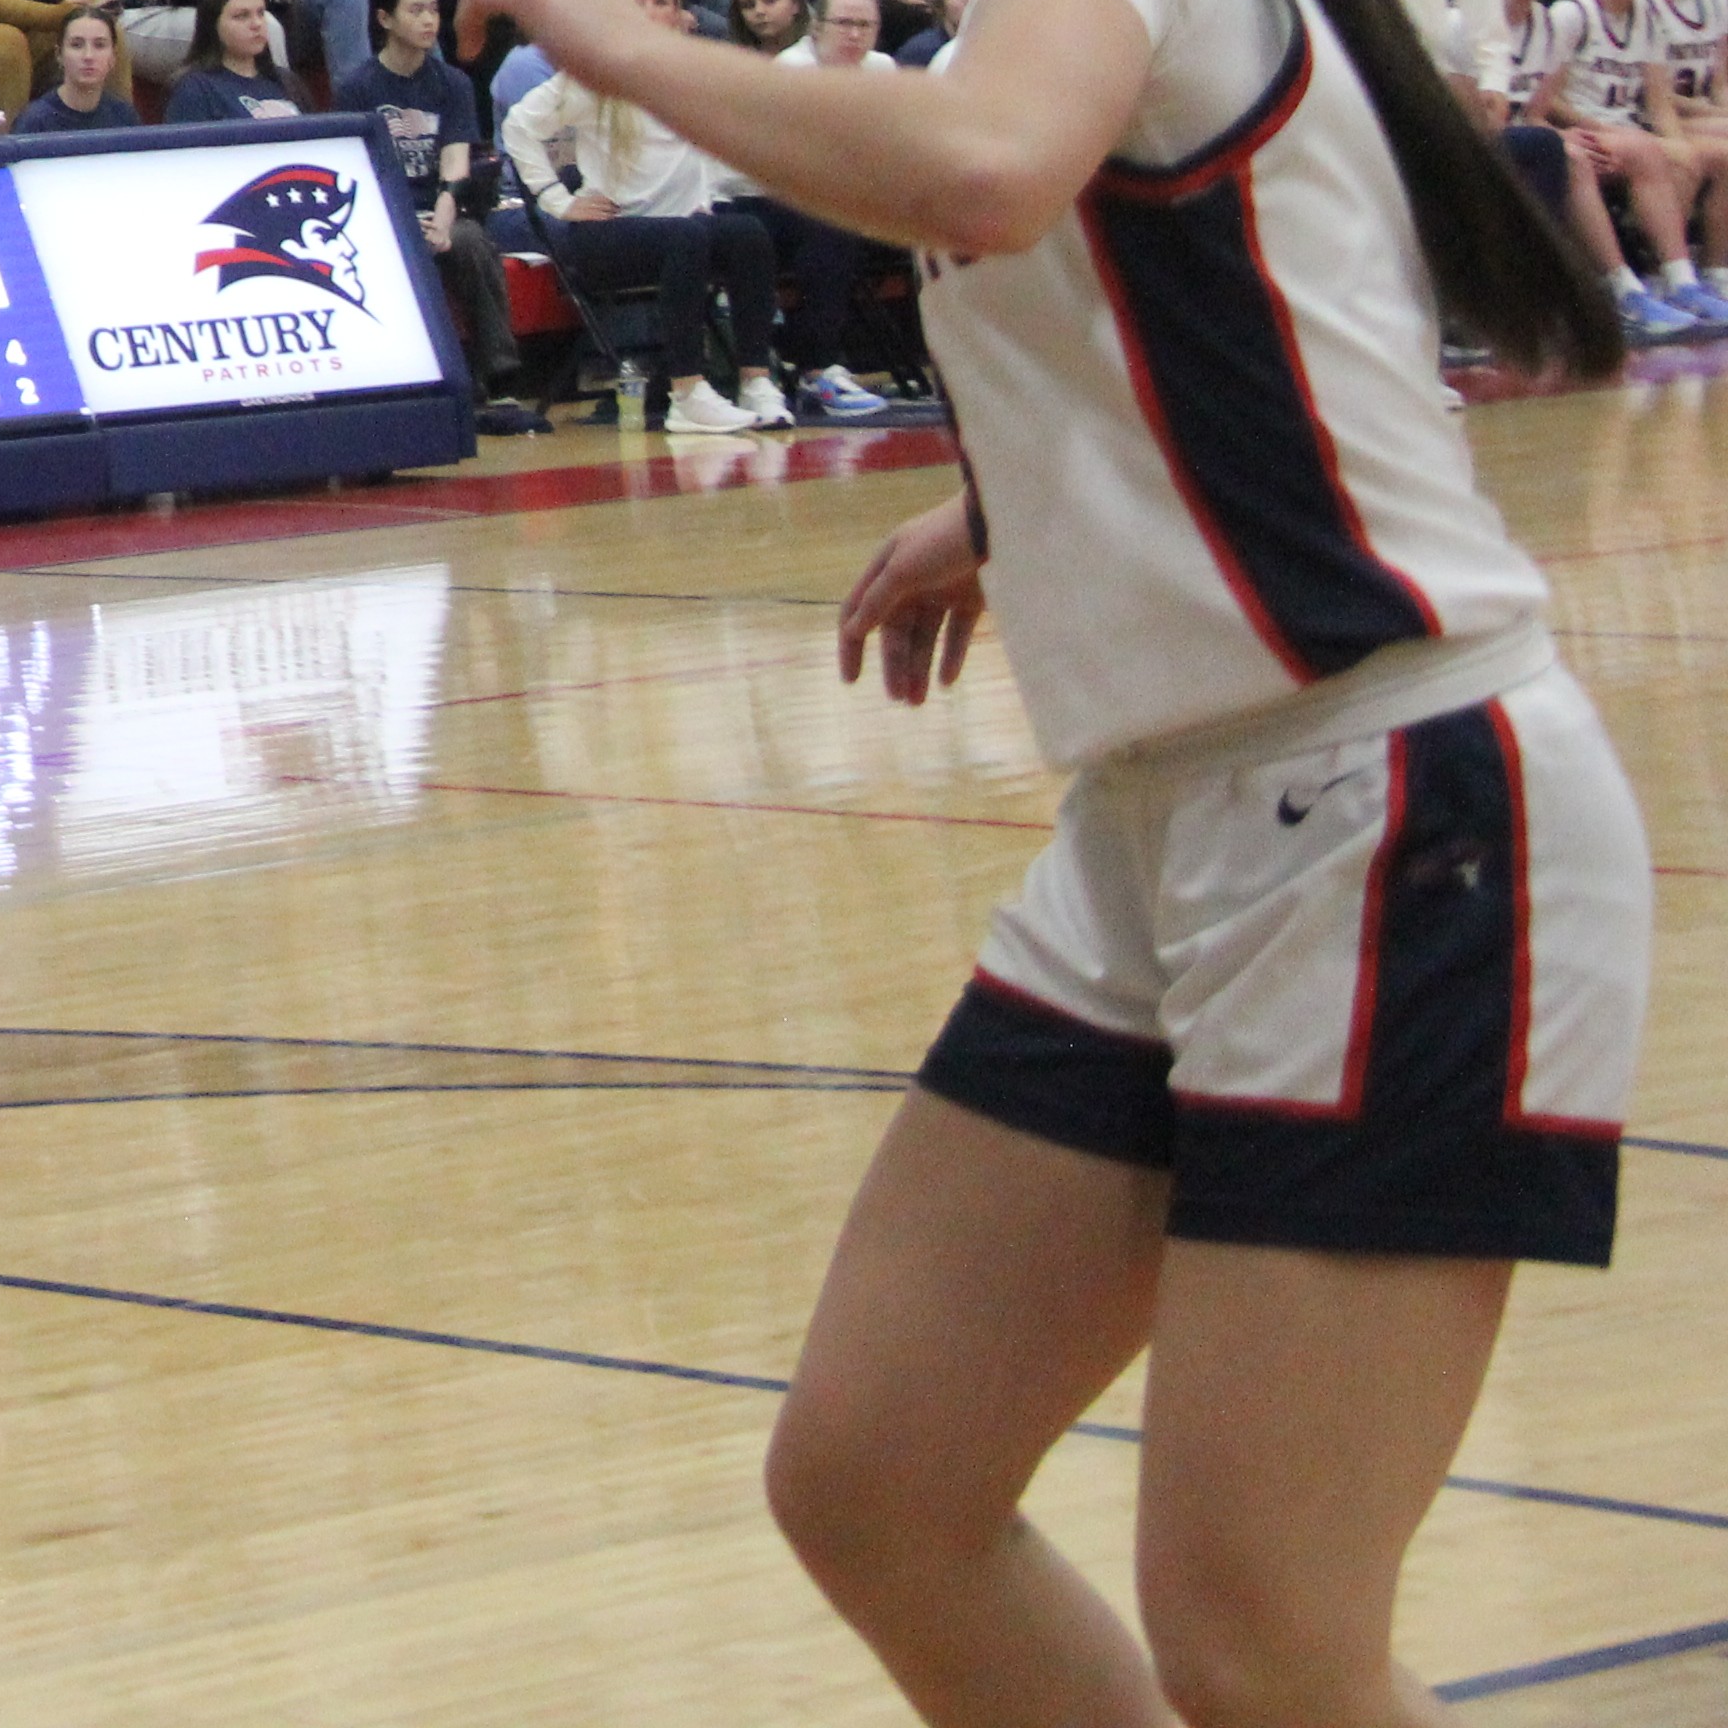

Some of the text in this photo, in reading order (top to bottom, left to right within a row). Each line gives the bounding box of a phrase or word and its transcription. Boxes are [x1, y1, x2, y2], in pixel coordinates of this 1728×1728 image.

[88, 308, 337, 372] CENTURY
[202, 356, 343, 383] PATRIOTS
[15, 377, 40, 405] 2
